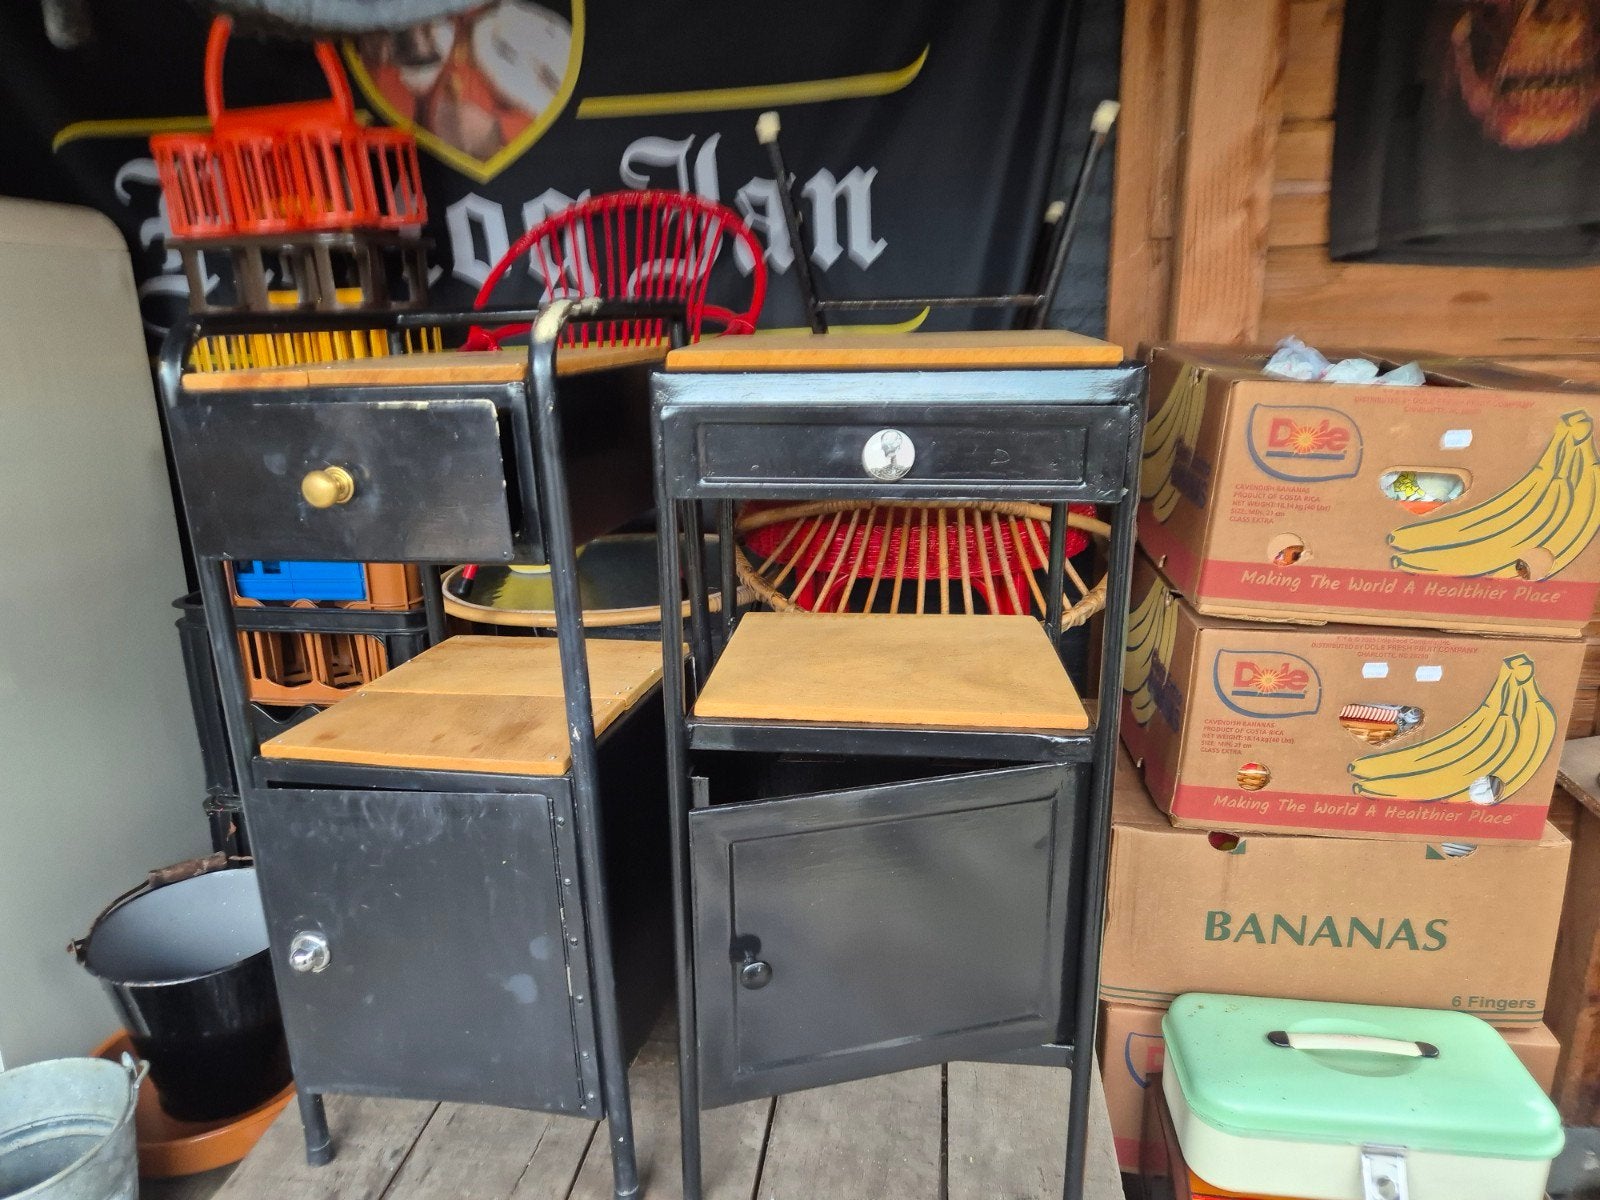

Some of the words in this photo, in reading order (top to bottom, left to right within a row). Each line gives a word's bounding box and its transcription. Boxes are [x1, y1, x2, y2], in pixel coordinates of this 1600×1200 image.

[1268, 418, 1350, 454] Dole
[1233, 491, 1266, 499] PRODUCT
[1235, 483, 1275, 492] CAVENDISH
[1276, 485, 1310, 493] BANANAS
[1240, 569, 1302, 593] Making
[1310, 574, 1341, 590] The
[1348, 576, 1398, 594] World
[1403, 580, 1416, 594] A
[1424, 582, 1508, 600] Healthier
[1311, 642, 1354, 650] DISTRIBUTED
[1364, 643, 1386, 651] DOLE
[1388, 644, 1413, 652] FRESH
[1438, 646, 1479, 654] COMPANY
[1233, 661, 1310, 692] Dole
[1203, 725, 1234, 733] PRODUCT
[1204, 718, 1242, 726] CAVENDISH
[1242, 720, 1276, 728] BANANAS
[1213, 794, 1270, 815] Making
[1278, 798, 1307, 813] The
[1313, 801, 1360, 816] World
[1365, 805, 1377, 817] A
[1385, 806, 1463, 822] Healthier
[1204, 910, 1449, 952] BANANAS
[1451, 995, 1462, 1008] 6
[1468, 995, 1536, 1011] Fingers
